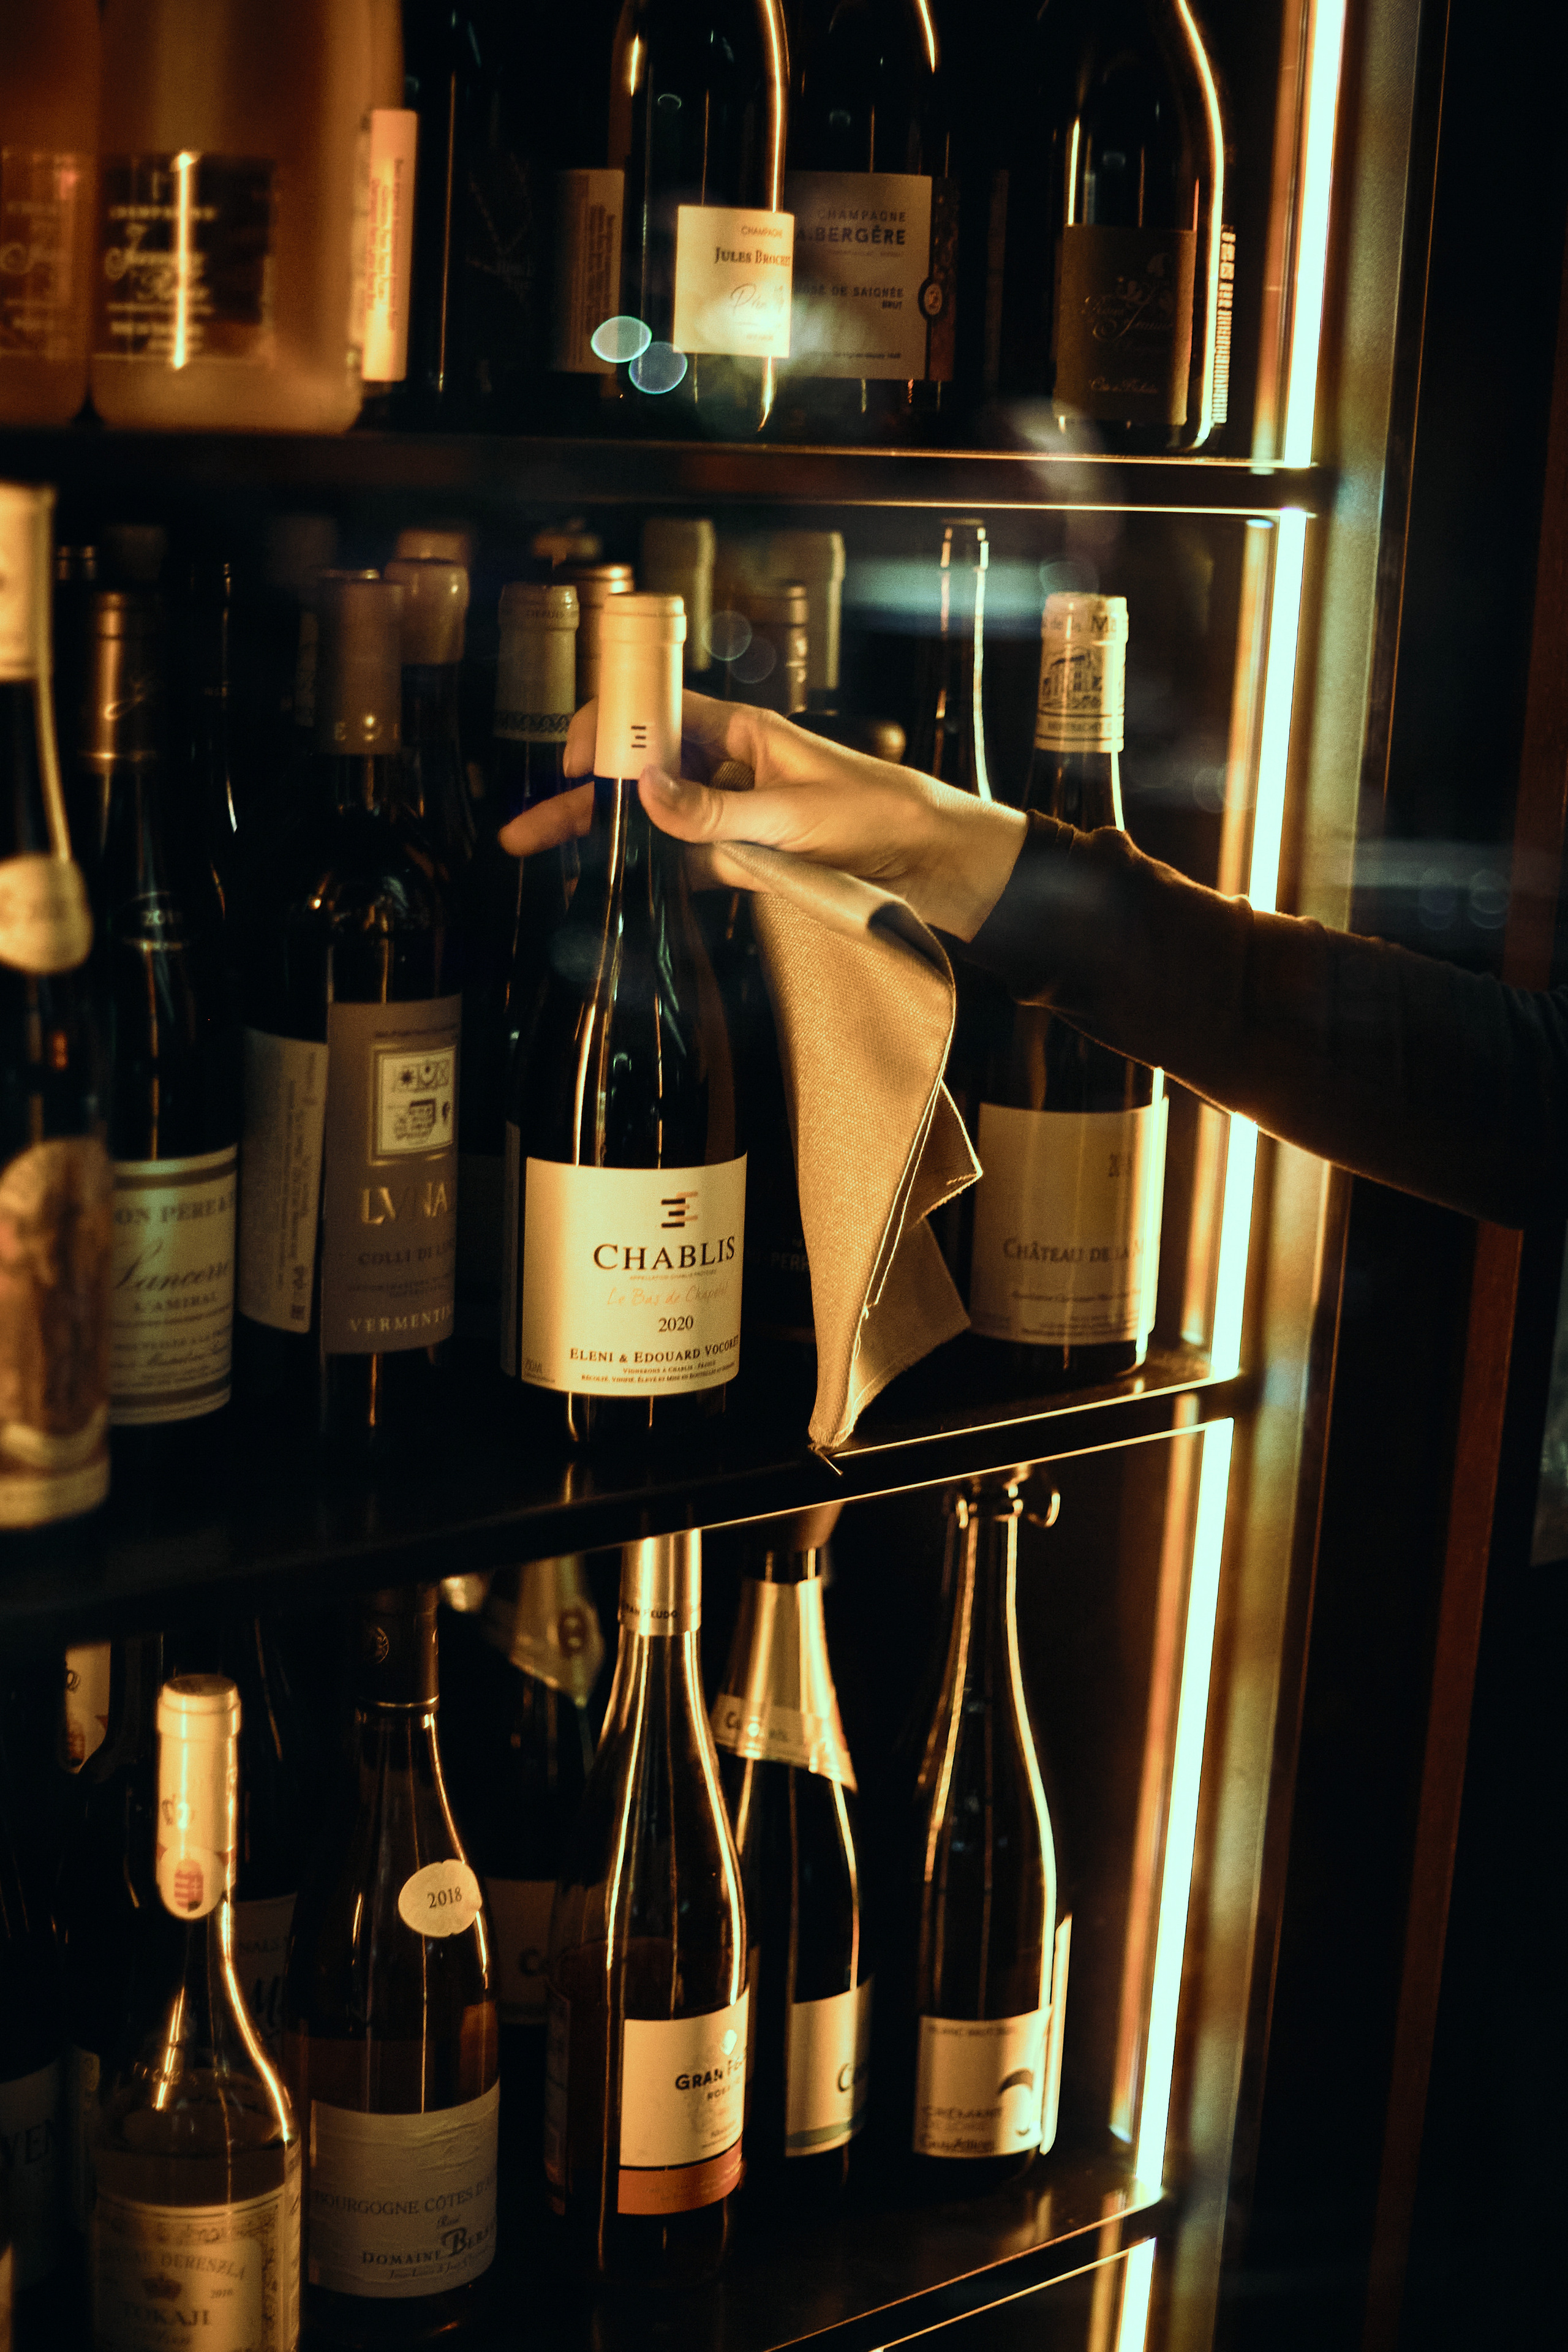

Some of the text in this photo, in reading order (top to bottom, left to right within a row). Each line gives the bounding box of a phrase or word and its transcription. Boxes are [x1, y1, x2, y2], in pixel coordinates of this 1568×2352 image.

[715, 246, 752, 264] JULES
[831, 285, 848, 297] DE
[593, 1235, 736, 1271] CHABLIS
[658, 1315, 694, 1333] 2020
[570, 1348, 614, 1363] ELENI
[619, 1353, 628, 1363] &
[634, 1348, 701, 1364] EDOUARD
[427, 1886, 462, 1909] 2018
[675, 2067, 724, 2090] GRAN
[361, 2250, 442, 2266] DOMAINE
